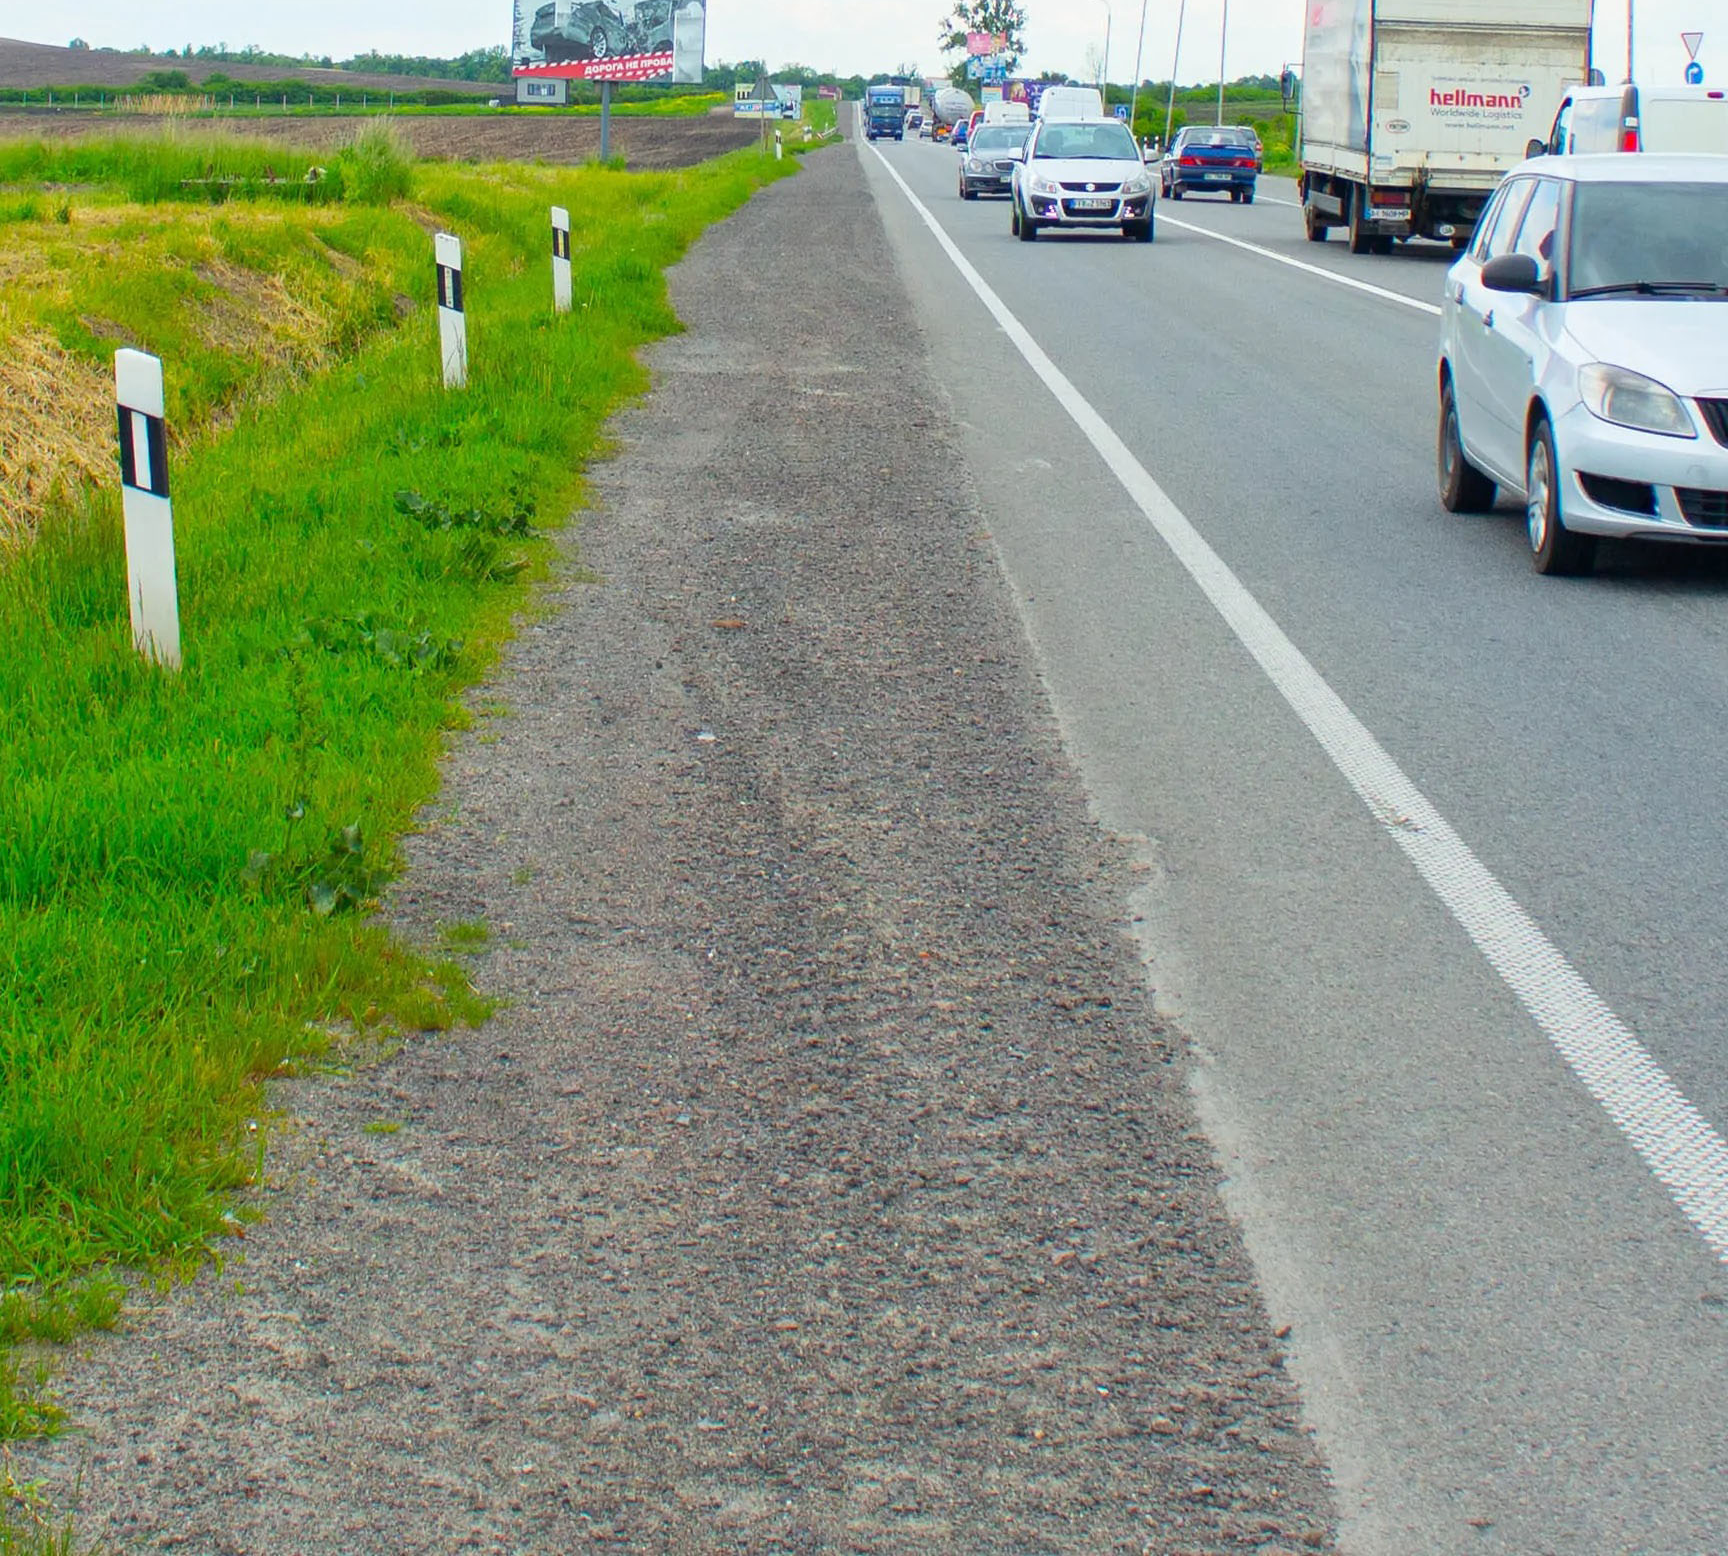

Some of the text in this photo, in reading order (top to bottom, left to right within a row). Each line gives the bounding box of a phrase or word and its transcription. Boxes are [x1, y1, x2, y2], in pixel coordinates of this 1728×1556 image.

[584, 63, 624, 76] ДОРОГА
[625, 61, 639, 71] НЕ
[1430, 88, 1522, 108] hellmann
[1431, 108, 1523, 120] Worldwide Logistics
